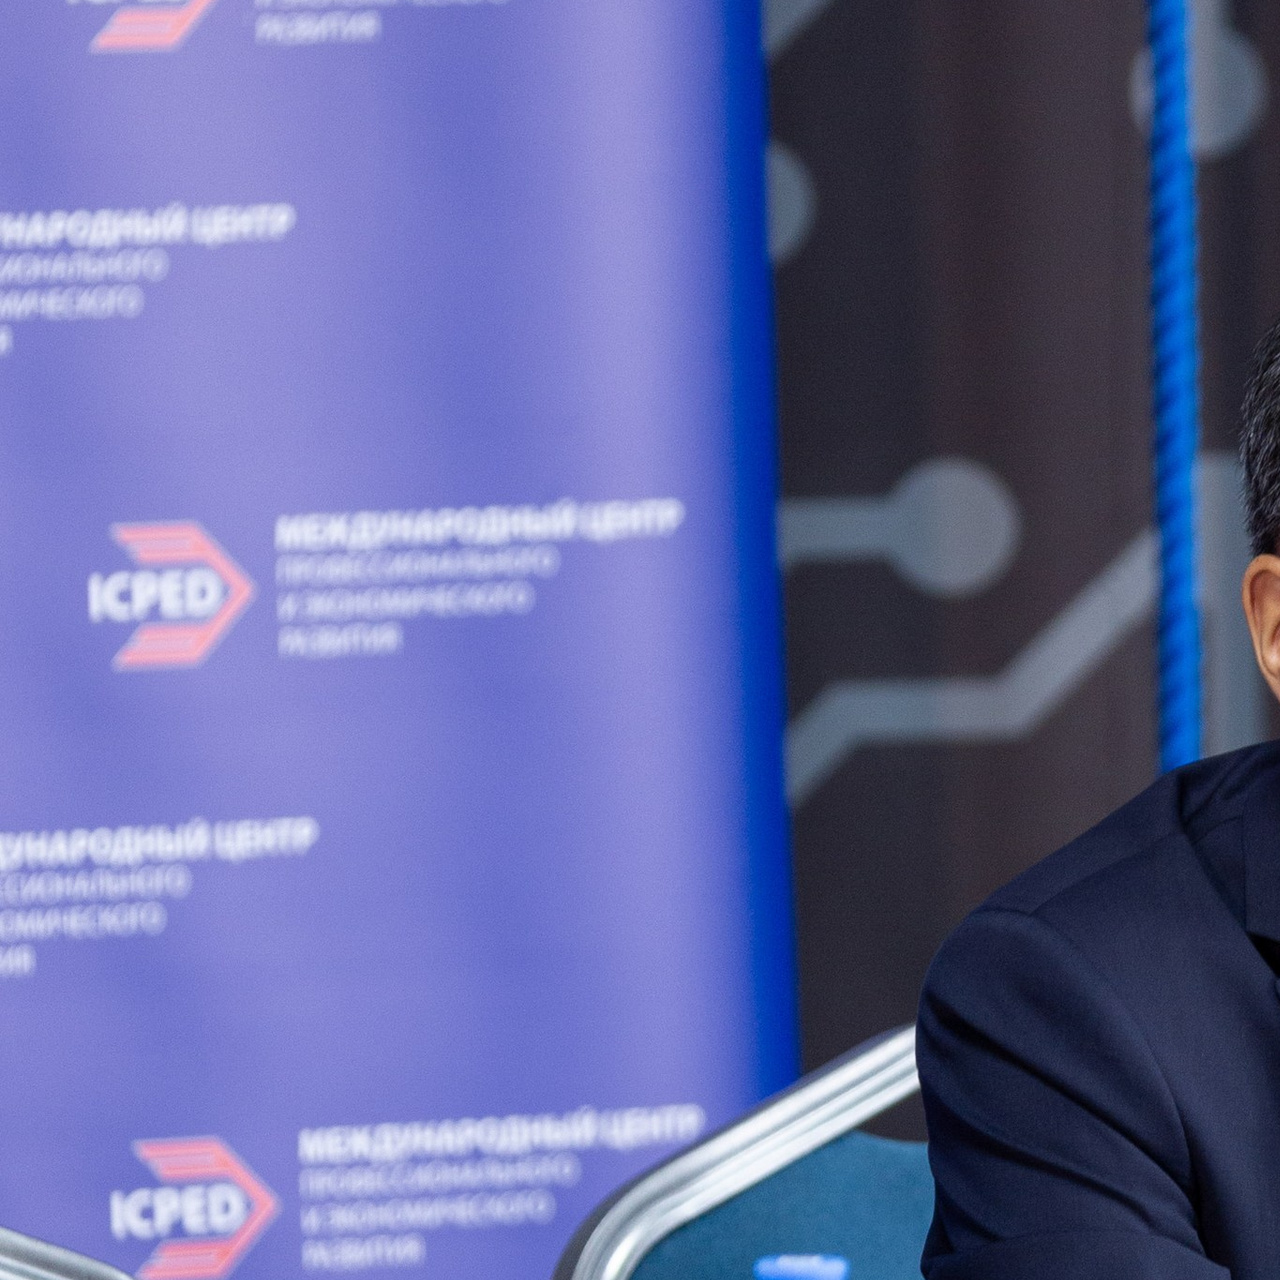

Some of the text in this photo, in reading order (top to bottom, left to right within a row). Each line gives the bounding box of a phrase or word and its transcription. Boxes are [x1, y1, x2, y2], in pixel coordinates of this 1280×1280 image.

[191, 203, 296, 248] ЦЕНТР
[88, 568, 224, 620] ICPED
[0, 816, 320, 871] УНАРОДНЫЙ ЦЕНТР
[111, 1183, 246, 1239] ICPED
